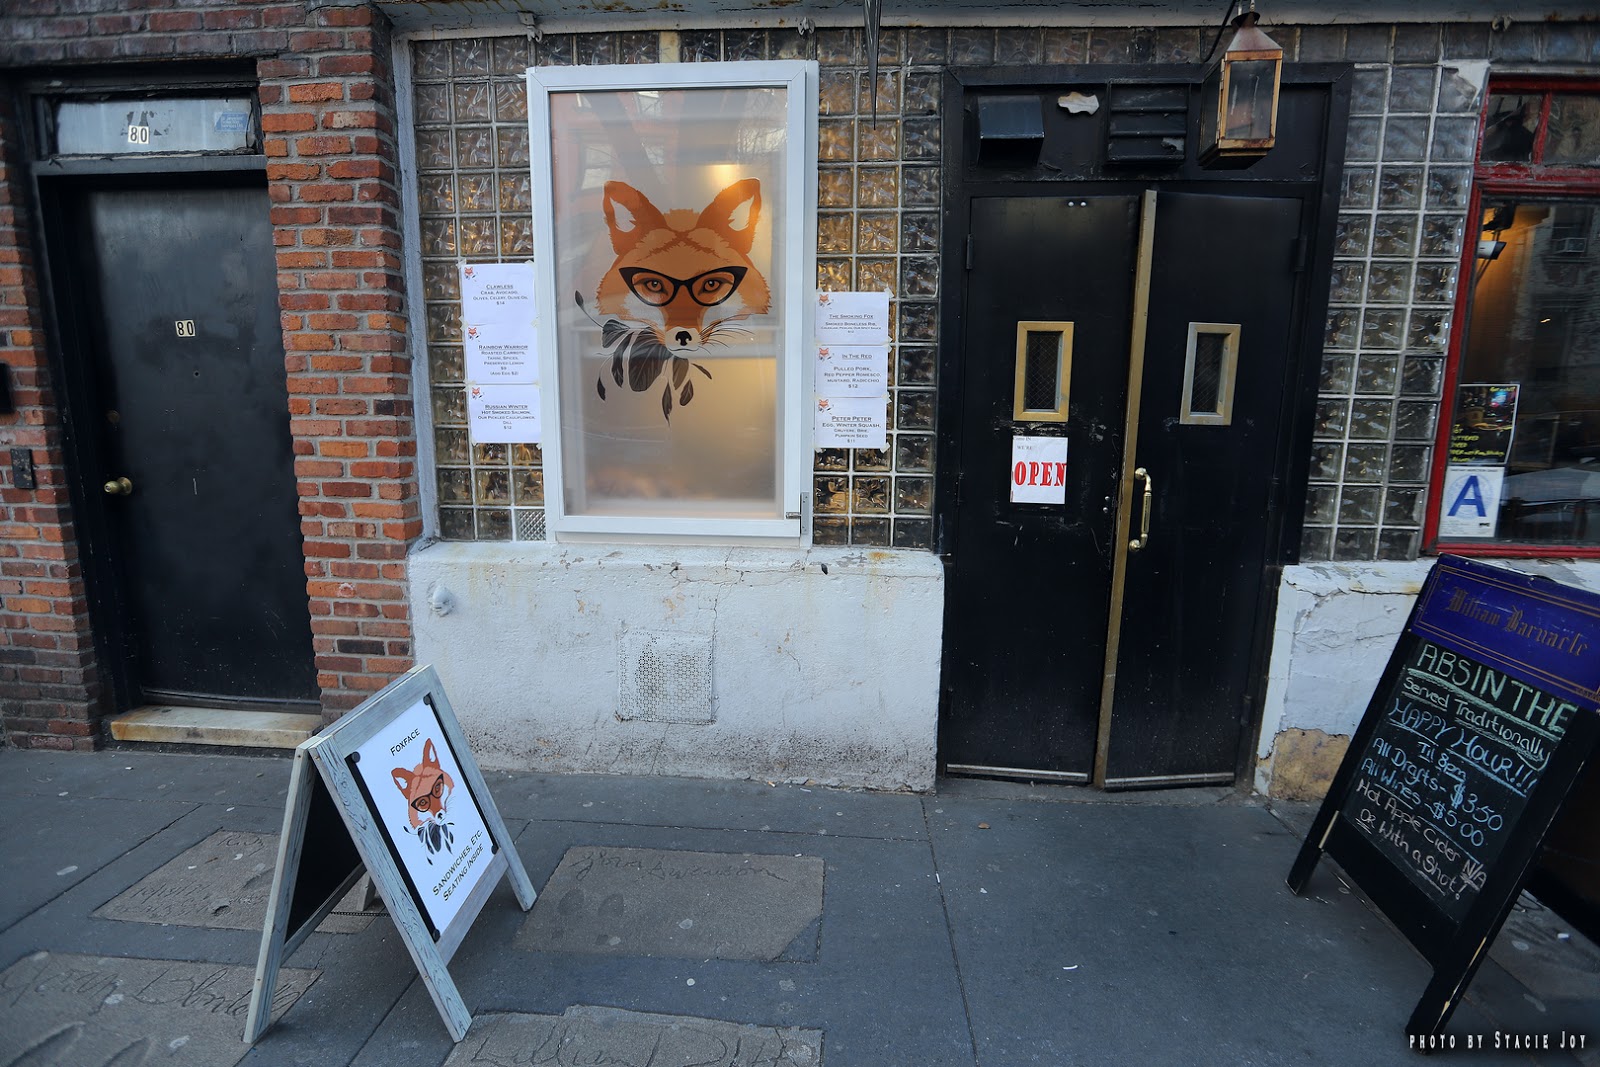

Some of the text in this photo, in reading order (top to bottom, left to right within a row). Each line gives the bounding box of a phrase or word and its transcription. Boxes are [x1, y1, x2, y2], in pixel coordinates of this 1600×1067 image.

[130, 126, 148, 143] 80
[176, 321, 194, 336] 80
[1014, 461, 1067, 487] OPEN
[1447, 475, 1487, 517] A
[1444, 586, 1588, 656] William Barnacle
[1416, 643, 1579, 734] ABSINTHE
[1388, 697, 1457, 740] HAPPY
[1403, 677, 1551, 771] Served Traditionally
[390, 727, 421, 757] FOXFACE
[1372, 737, 1391, 758] All
[1361, 757, 1379, 777] All
[1379, 769, 1421, 805] Wines
[1356, 778, 1381, 806] Hot
[1383, 798, 1422, 833] Apple
[1423, 828, 1461, 862] Cider
[1379, 820, 1409, 853] With
[1412, 849, 1421, 865] a
[432, 830, 483, 897] SANDWICHES, ETC.
[442, 842, 484, 902] SEATING INSIDE
